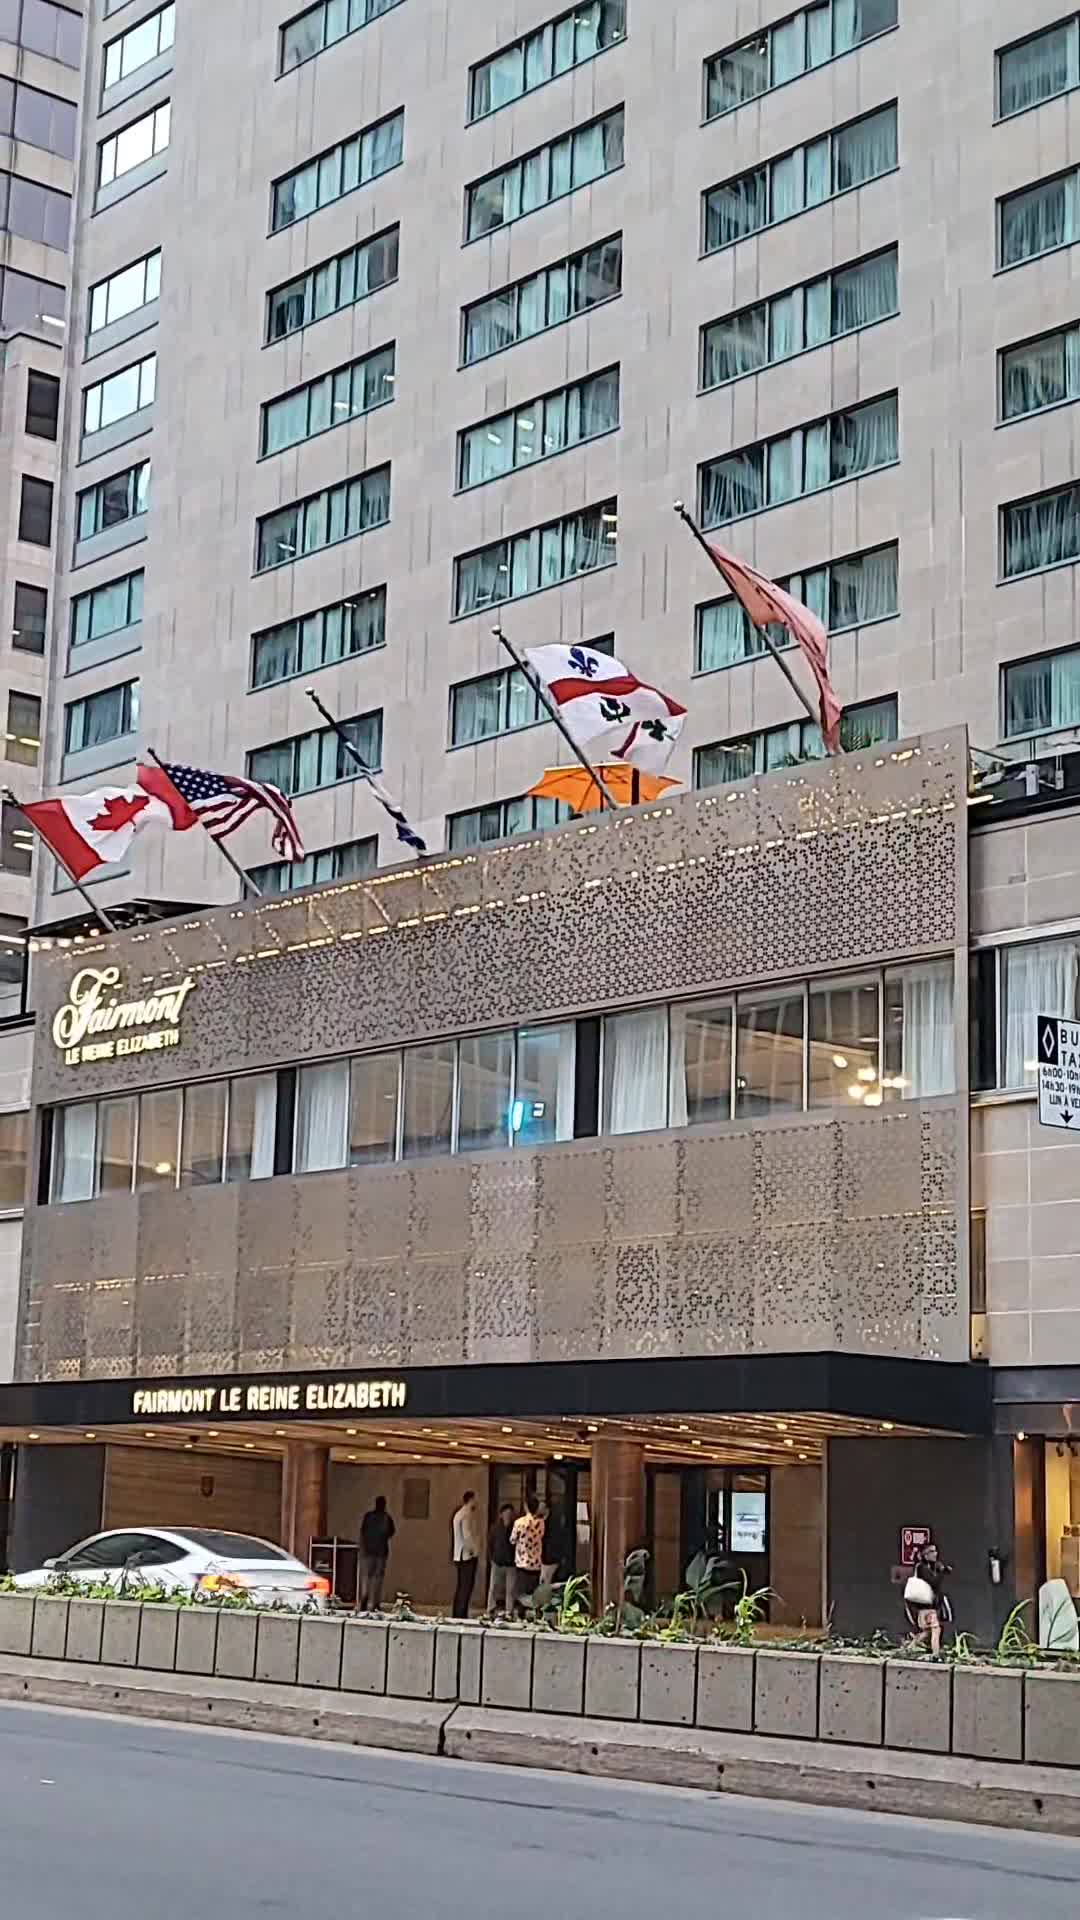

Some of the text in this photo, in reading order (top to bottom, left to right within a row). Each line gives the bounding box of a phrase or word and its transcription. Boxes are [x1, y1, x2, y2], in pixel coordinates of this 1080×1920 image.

[53, 967, 196, 1049] Fairmont
[65, 1047, 80, 1065] LE
[116, 1029, 179, 1056] ELIZABETH
[1061, 1050, 1080, 1068] TA
[1070, 1097, 1080, 1109] VE
[133, 1381, 406, 1414] FAIRMONT LE REINE ELIZABETH
